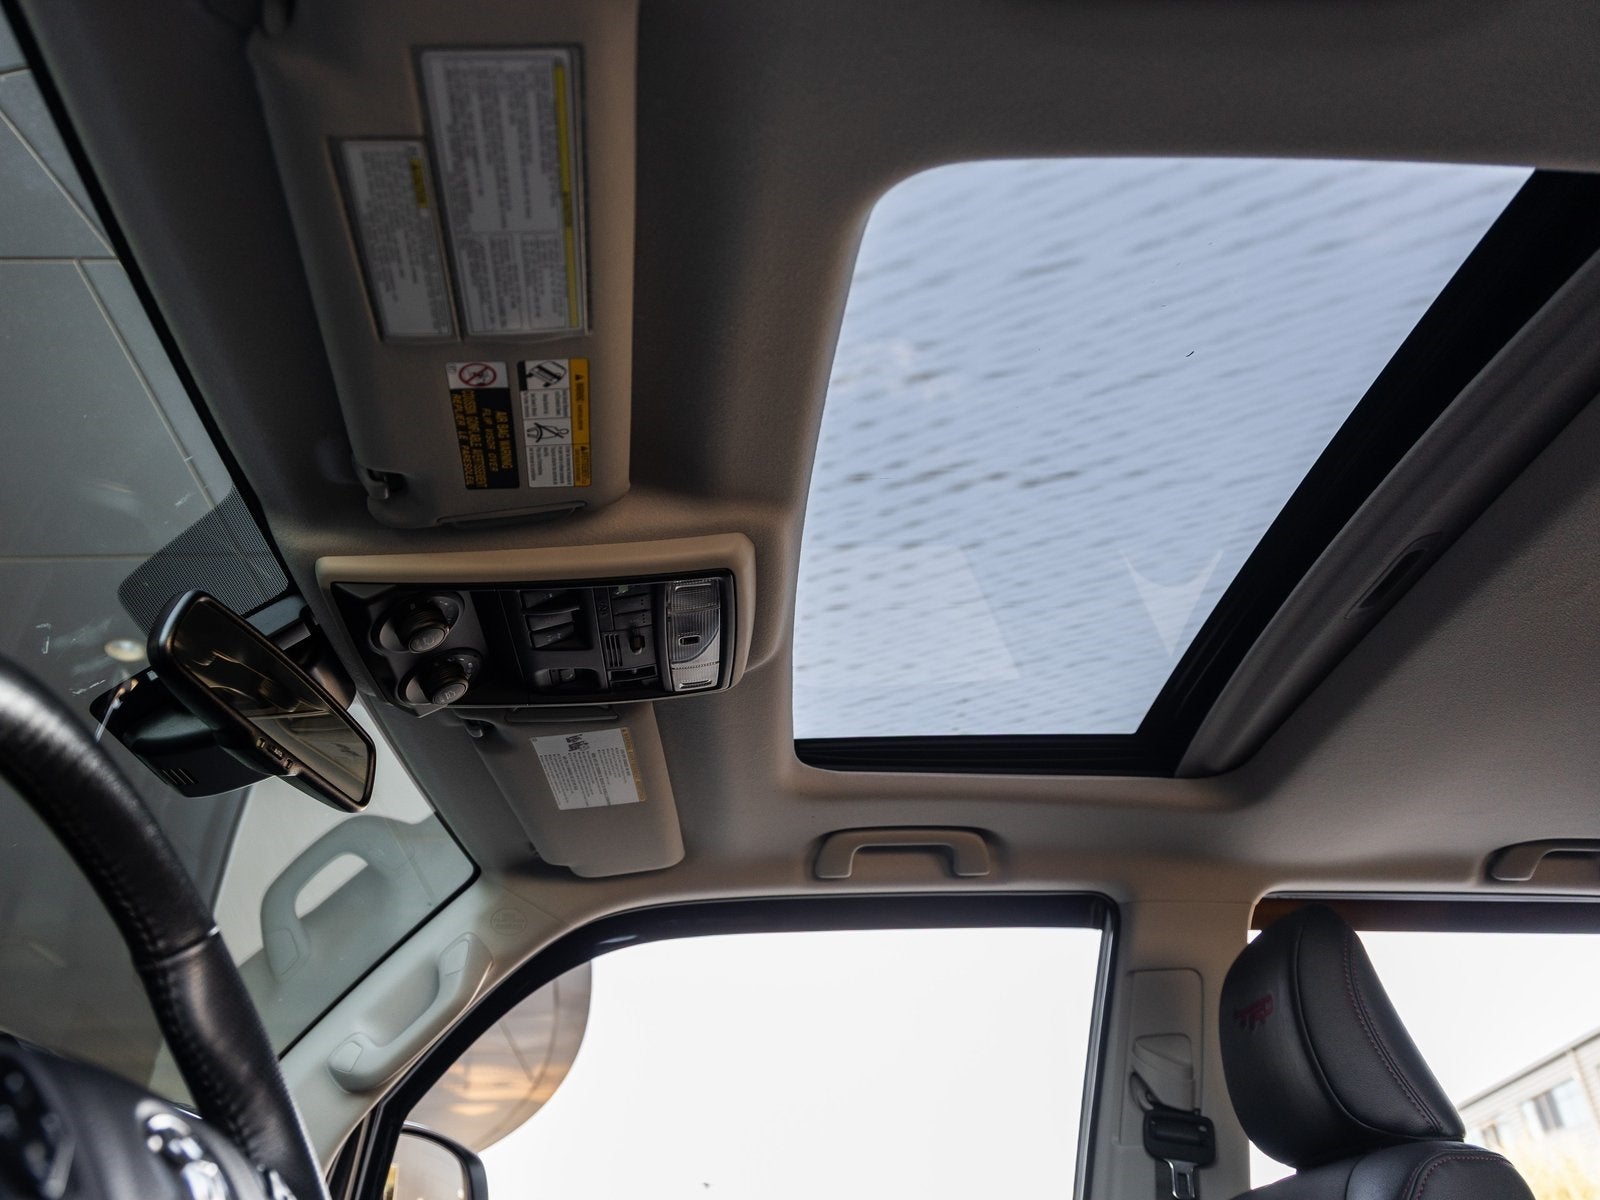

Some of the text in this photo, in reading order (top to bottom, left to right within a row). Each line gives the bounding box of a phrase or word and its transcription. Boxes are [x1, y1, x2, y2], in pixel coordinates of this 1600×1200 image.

[485, 428, 496, 450] VISOR
[496, 410, 513, 469] AIR BAG WARNING
